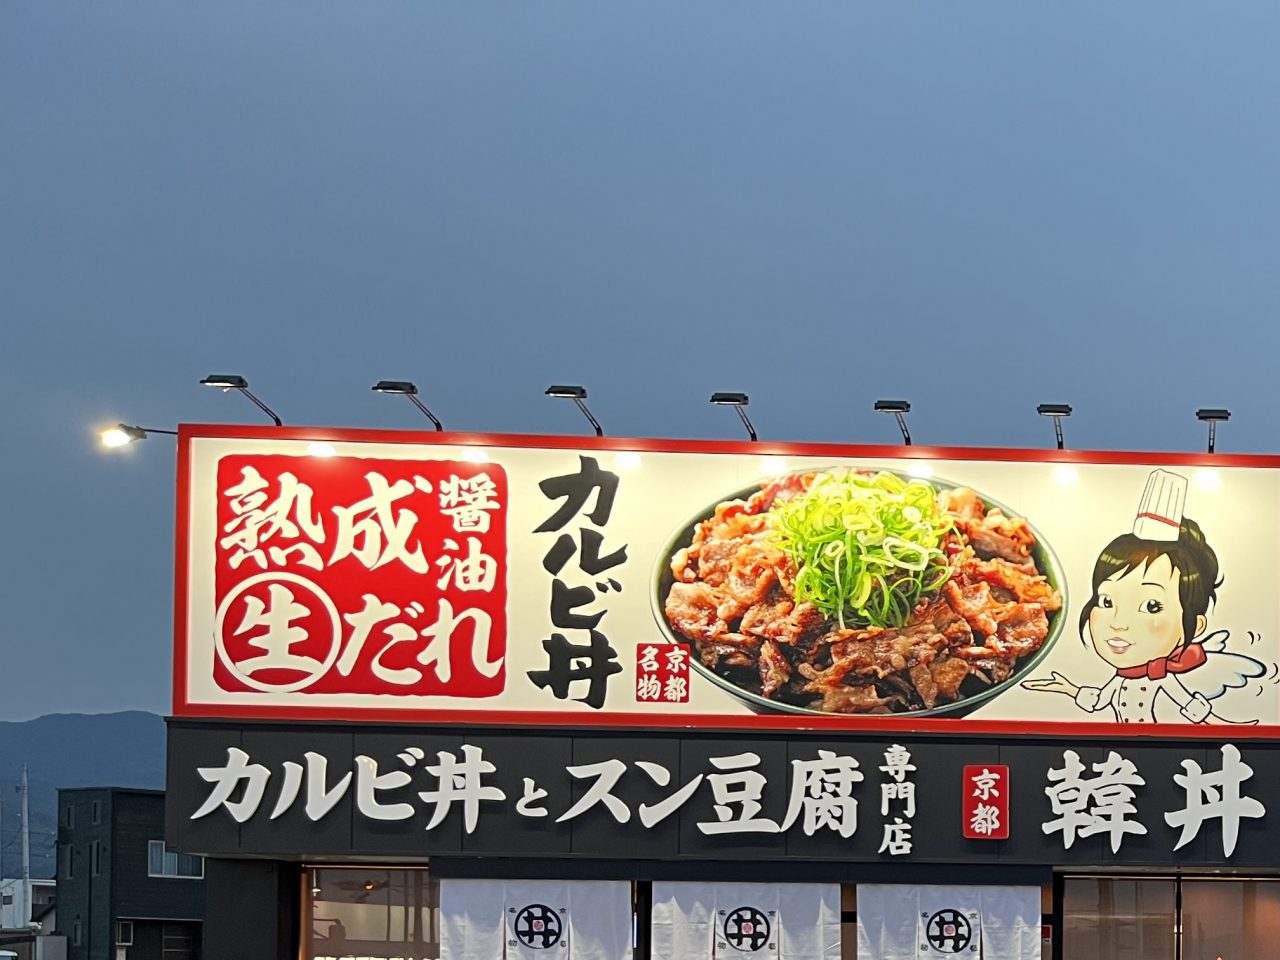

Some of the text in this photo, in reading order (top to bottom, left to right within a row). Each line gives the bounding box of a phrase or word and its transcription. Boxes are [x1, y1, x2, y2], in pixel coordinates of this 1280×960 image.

[220, 465, 432, 575] 熟成
[435, 473, 502, 593] 醤油
[526, 454, 628, 710] カルビ丼
[637, 646, 661, 701] 名物
[663, 645, 689, 702] 京都
[878, 743, 917, 857] 専門店
[970, 767, 1001, 837] 京都
[1041, 742, 1267, 859] 韓丼
